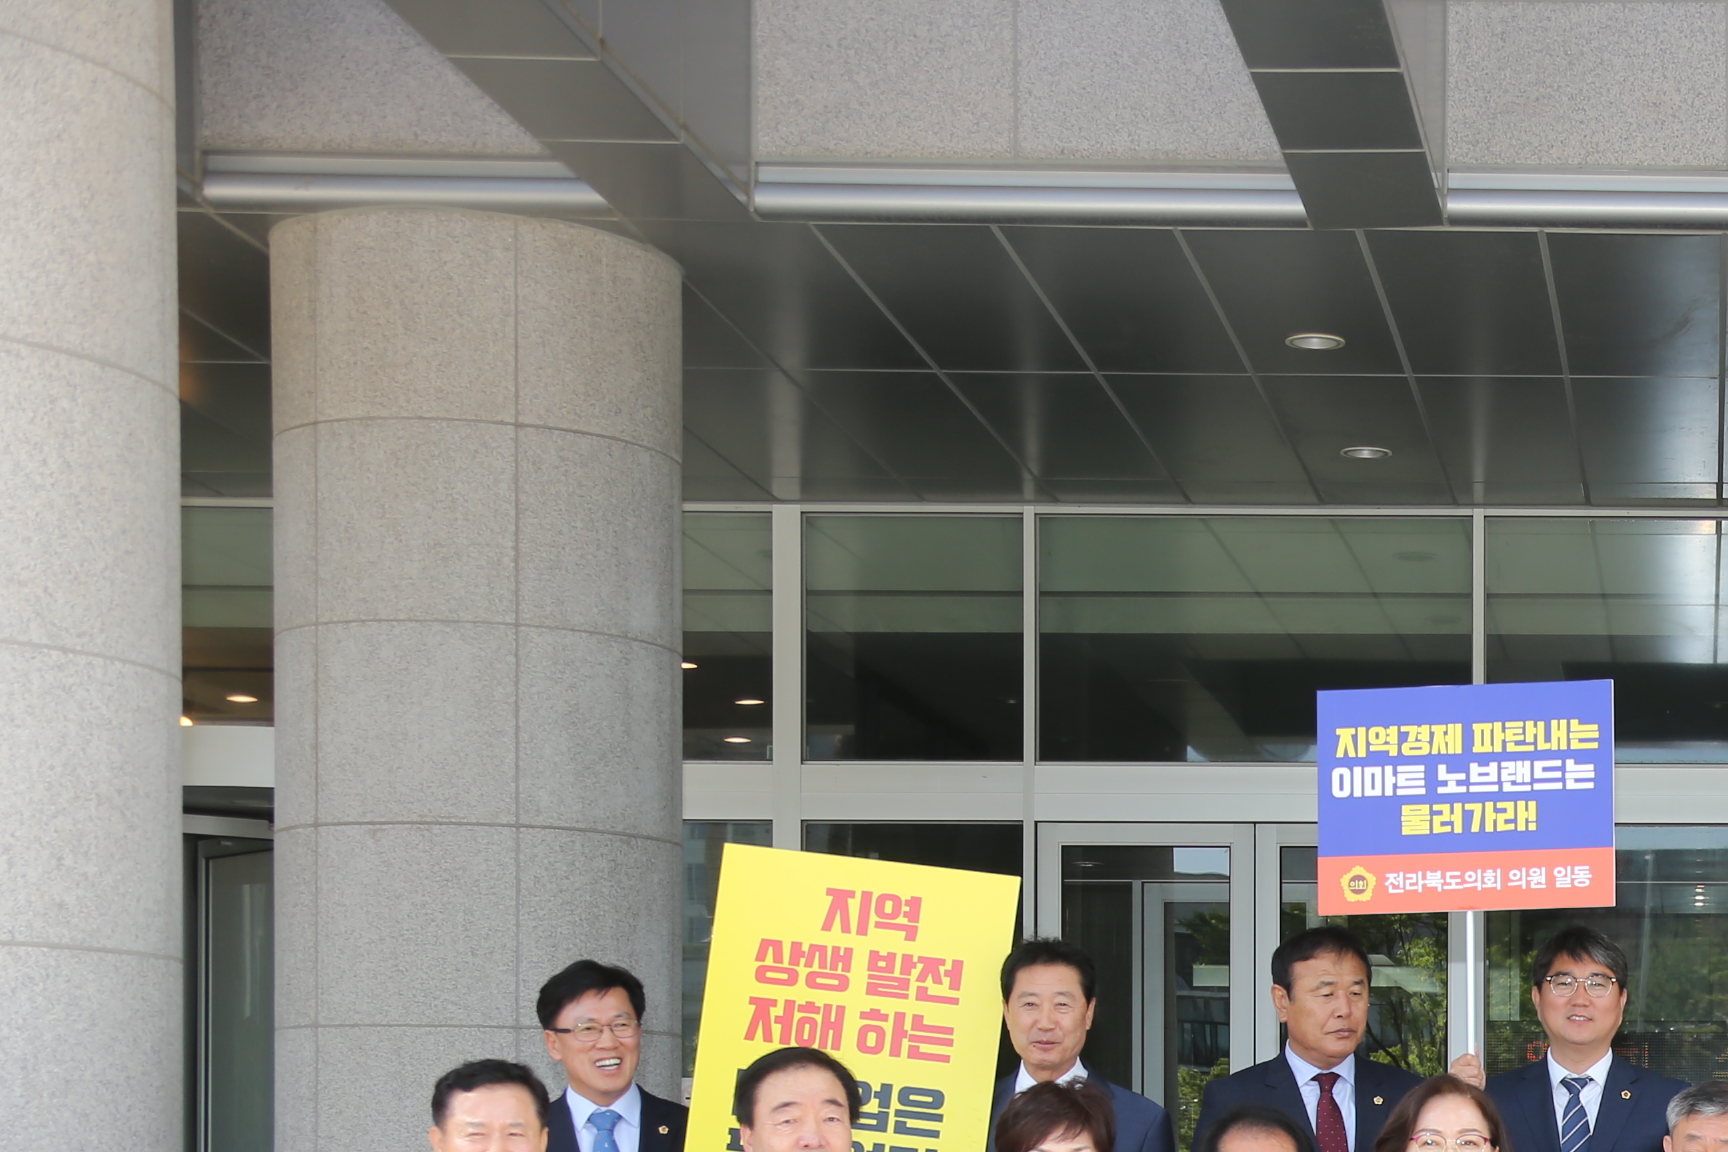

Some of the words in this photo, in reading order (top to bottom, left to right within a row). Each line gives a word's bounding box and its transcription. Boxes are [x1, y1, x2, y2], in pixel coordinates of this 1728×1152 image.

[1335, 722, 1463, 758] 지역경제
[1472, 718, 1599, 753] 파탄내는
[1331, 764, 1426, 798] 이마트
[1437, 758, 1595, 794] 노브랜드는
[1401, 800, 1537, 835] 물러가라!
[1384, 868, 1501, 893] 전라북도의회
[1508, 867, 1546, 888] 의원
[1553, 865, 1592, 887] 일동
[821, 887, 922, 942] 지역
[754, 938, 854, 993] 상생
[865, 950, 964, 1005] 발전
[743, 996, 846, 1052] 저해
[856, 1008, 955, 1064] 하는
